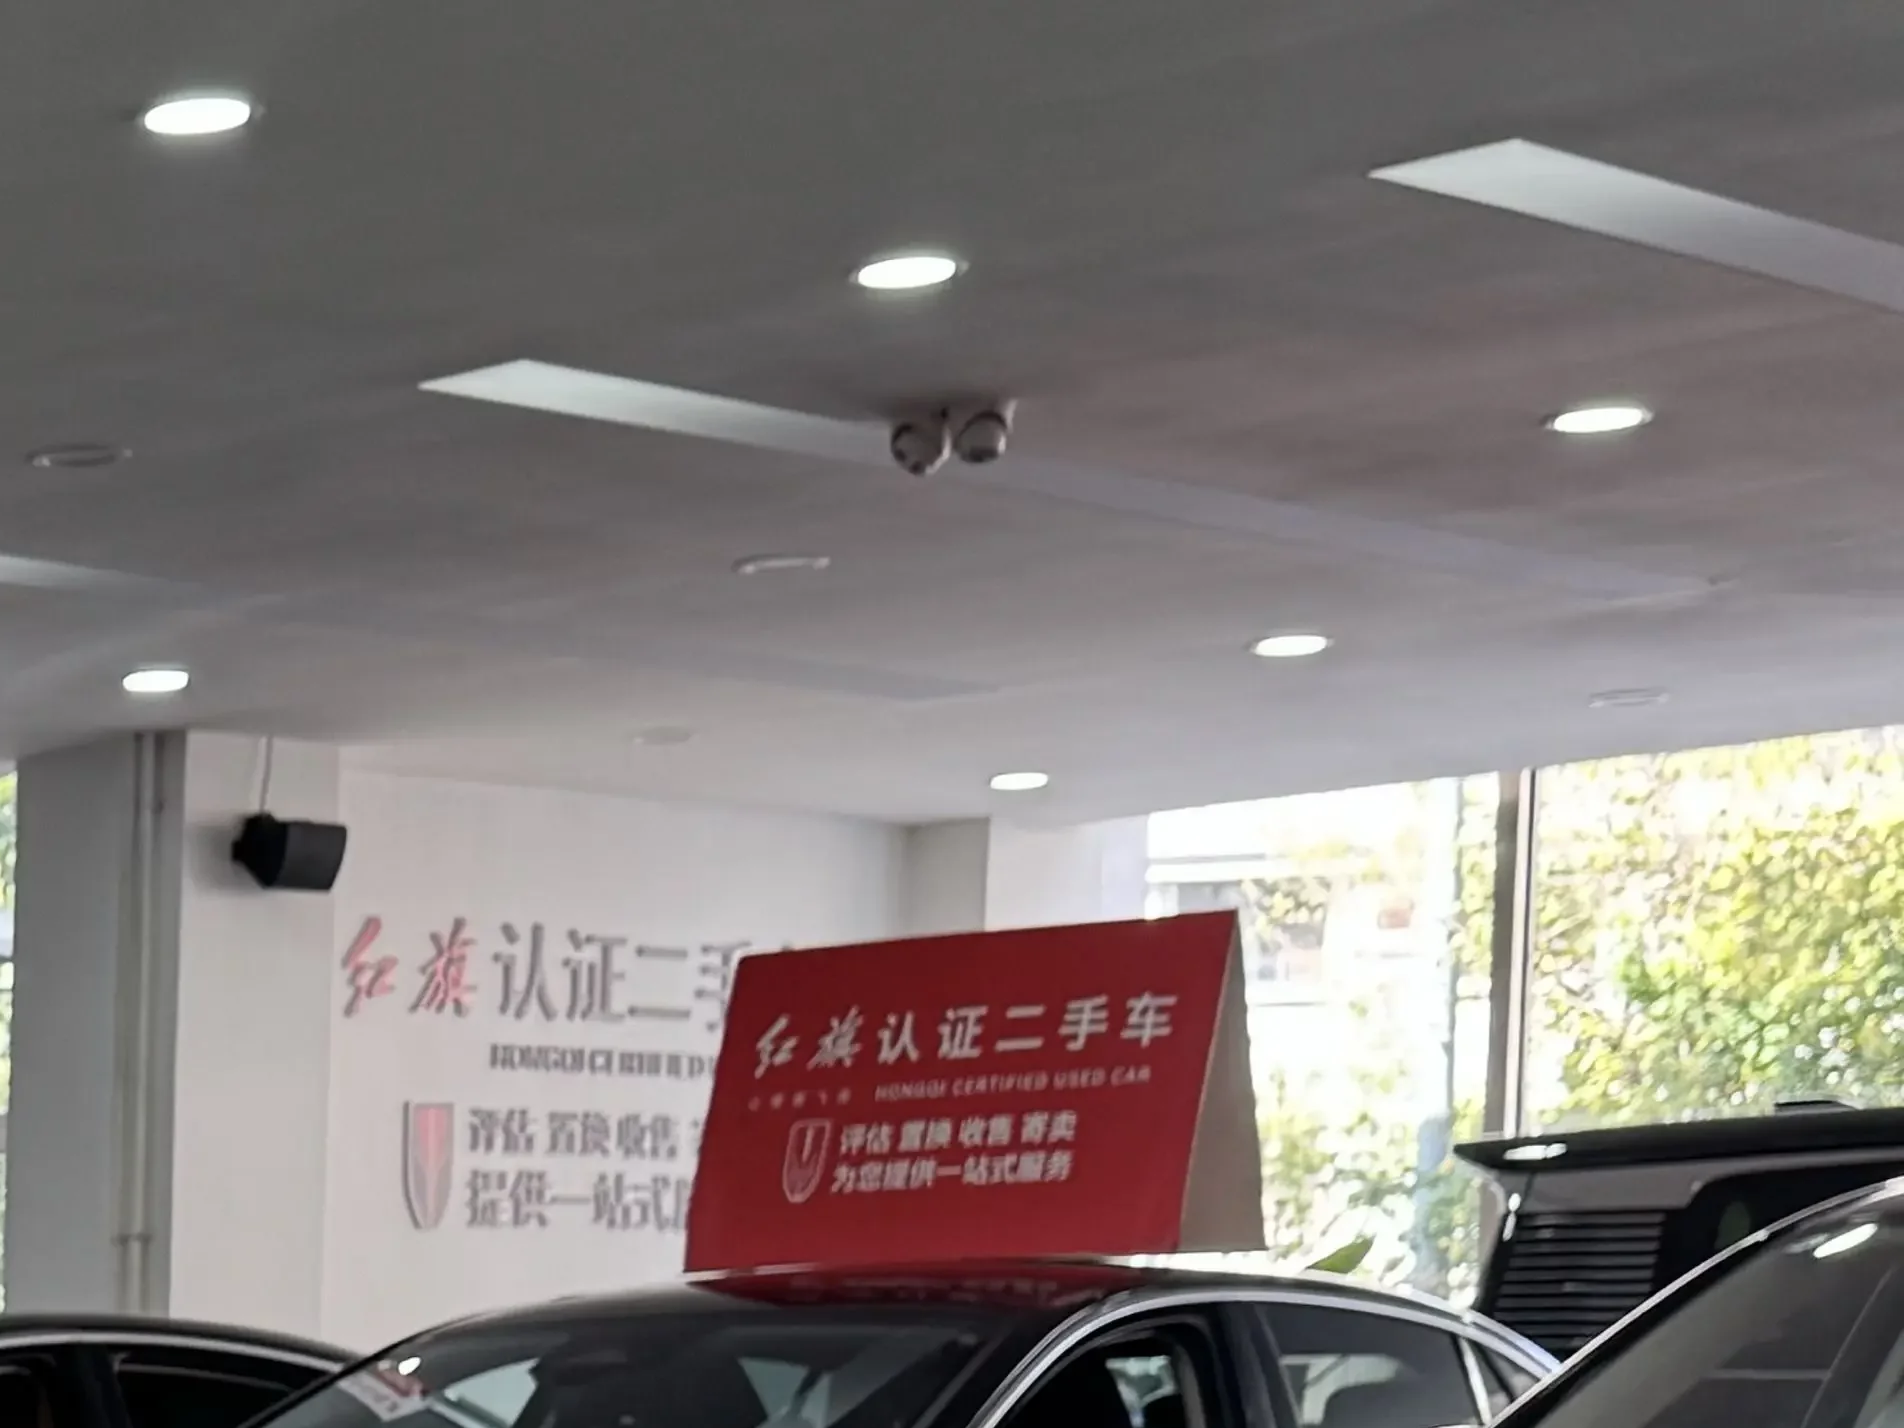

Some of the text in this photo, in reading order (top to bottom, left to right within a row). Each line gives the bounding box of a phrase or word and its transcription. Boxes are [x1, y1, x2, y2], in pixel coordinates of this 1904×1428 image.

[342, 915, 794, 1032] 红旗 认证二手
[754, 991, 1178, 1079] 红旗 认证二手车
[951, 1071, 1048, 1097] CERTIFIED
[838, 1120, 894, 1156] 评估
